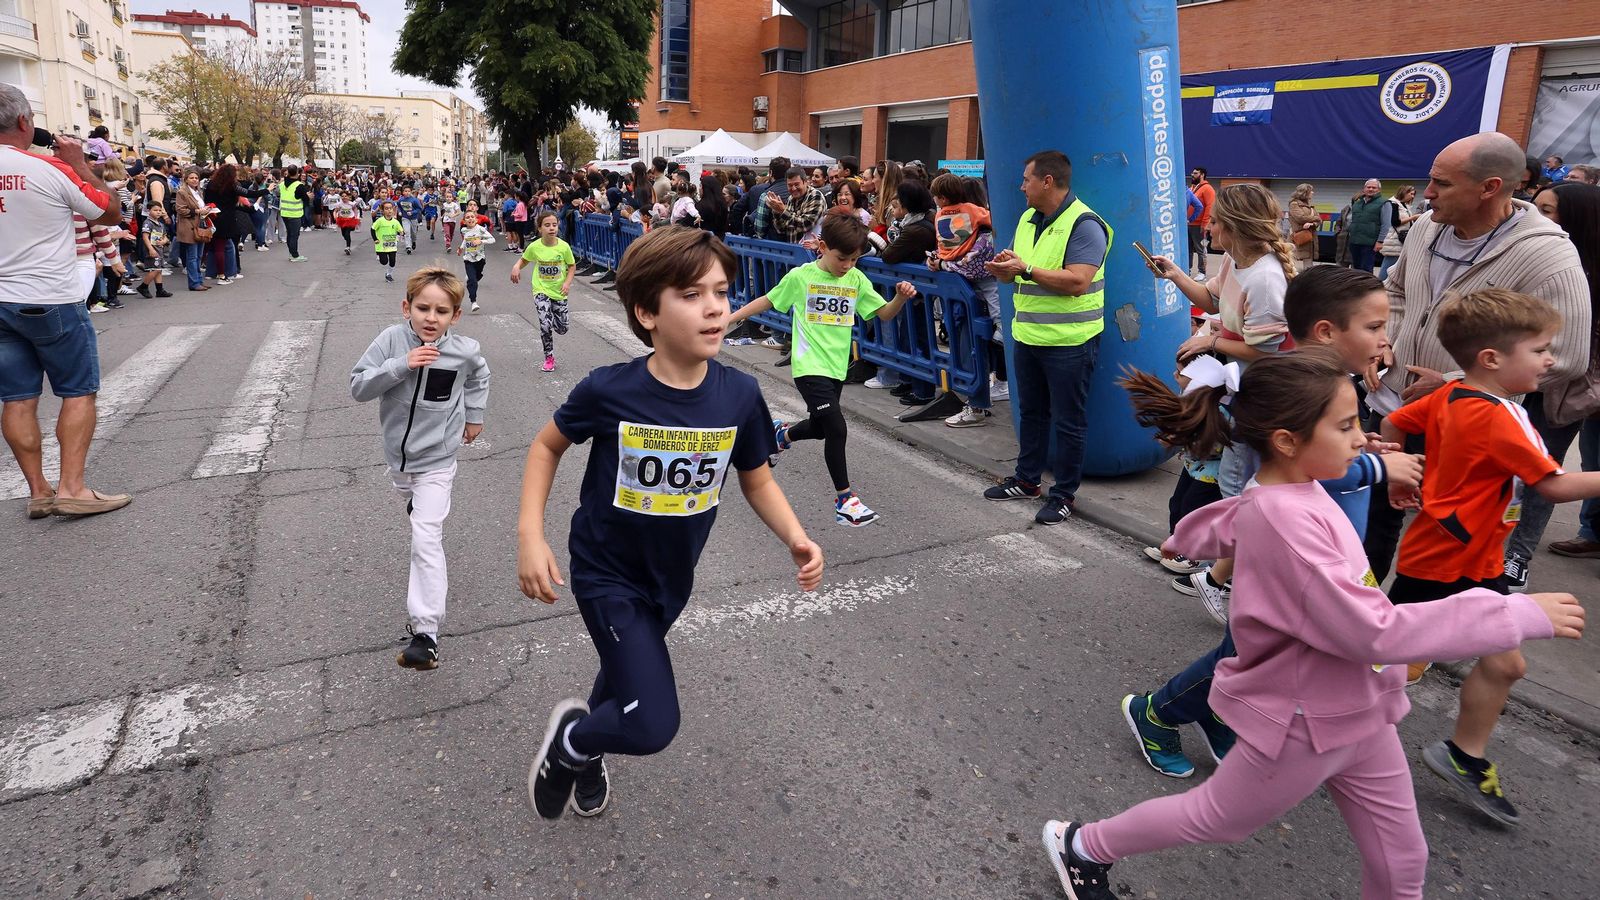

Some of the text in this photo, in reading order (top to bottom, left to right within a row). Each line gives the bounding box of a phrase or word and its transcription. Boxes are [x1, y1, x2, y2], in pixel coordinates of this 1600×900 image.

[1388, 67, 1418, 89] BOMBEROS
[1433, 71, 1446, 99] PROVINCIA
[815, 297, 849, 313] 586
[628, 426, 732, 442] CARRERA INFANTIL BENEFICA
[643, 439, 720, 452] BOMBEROS DE JEREZ
[637, 456, 718, 489] 065
